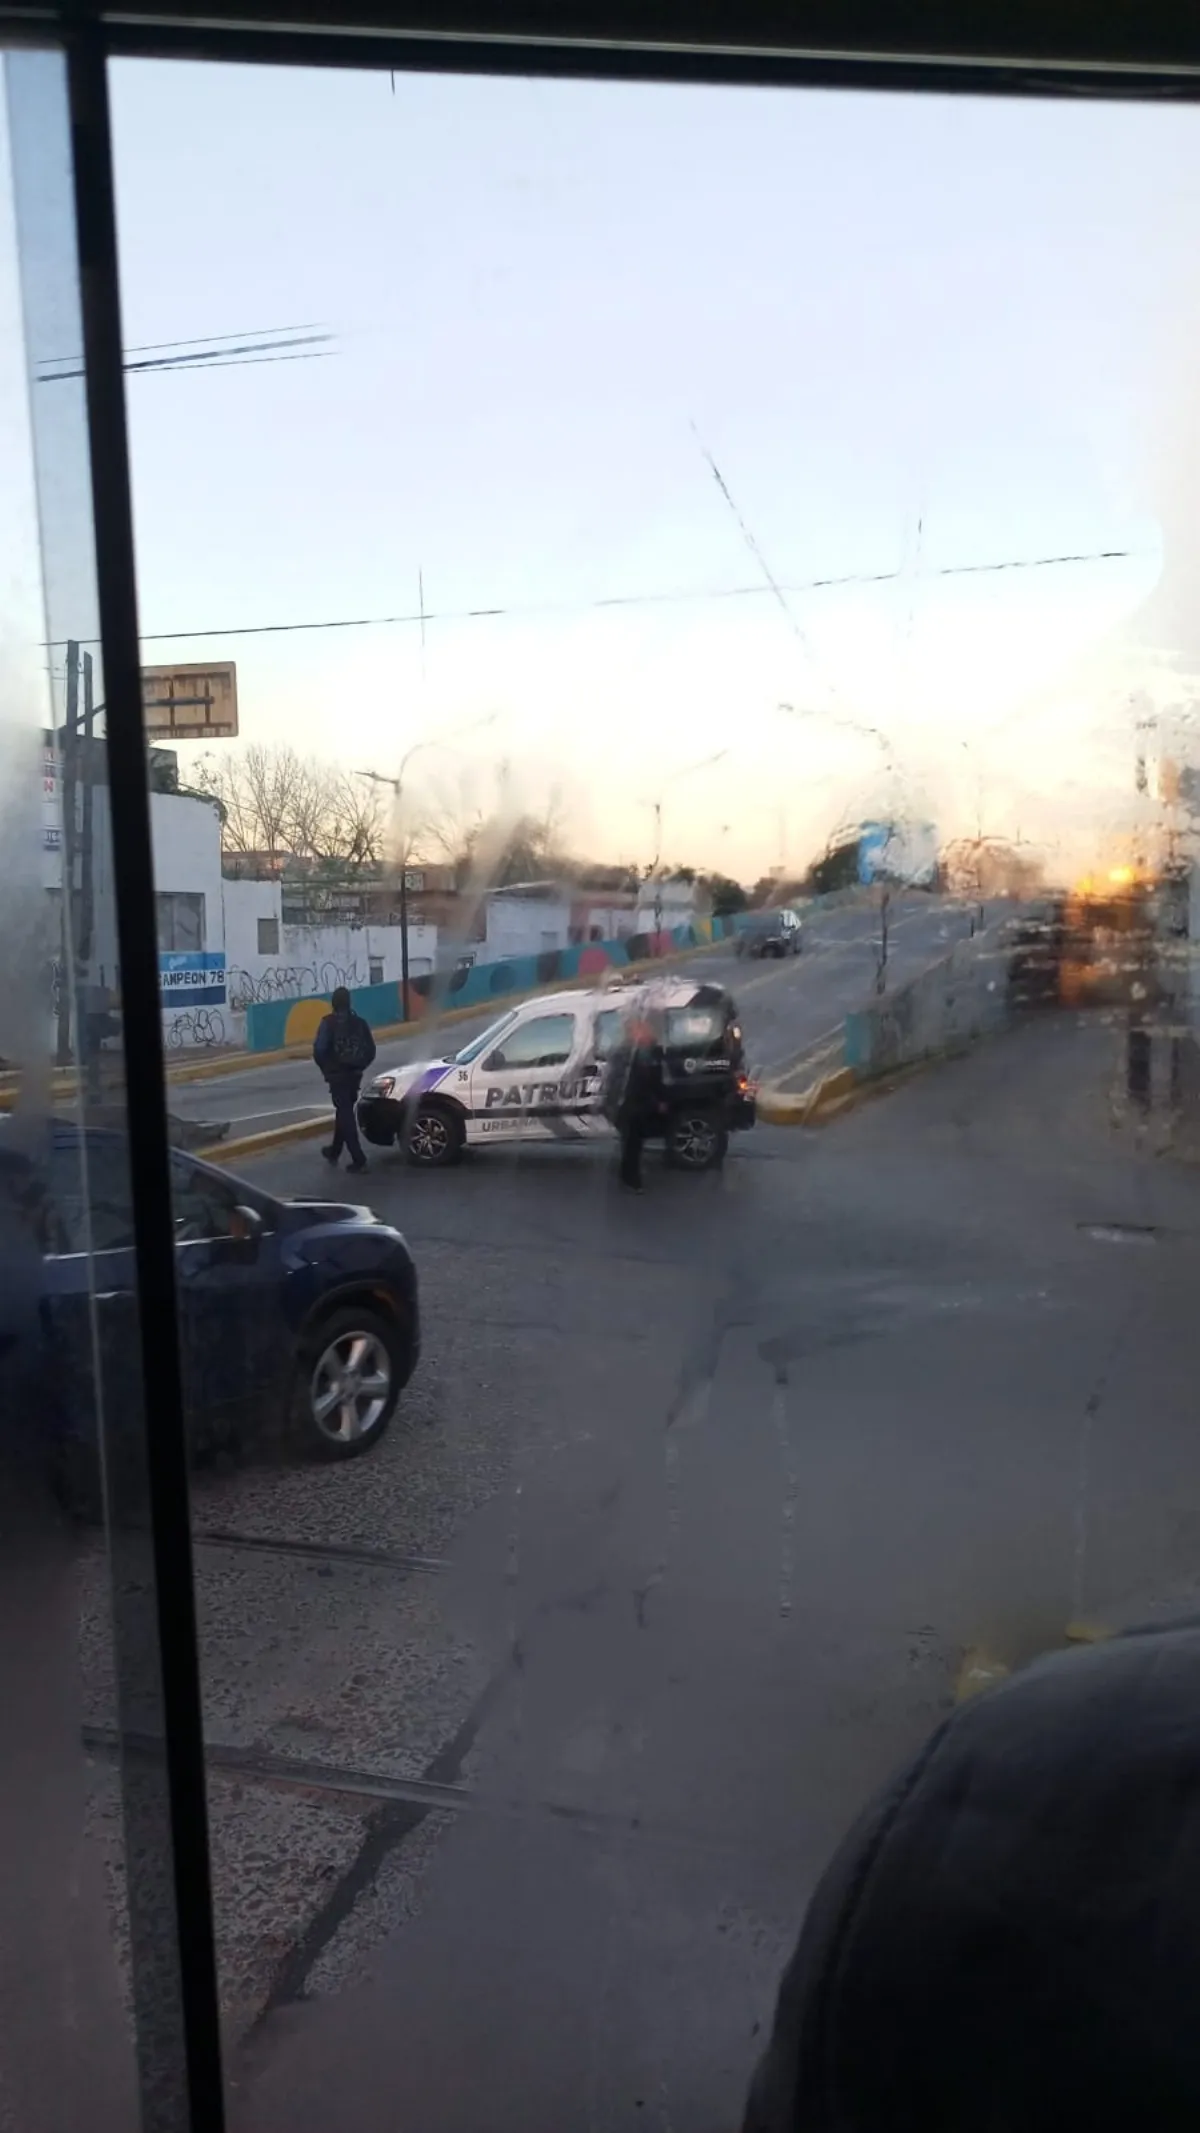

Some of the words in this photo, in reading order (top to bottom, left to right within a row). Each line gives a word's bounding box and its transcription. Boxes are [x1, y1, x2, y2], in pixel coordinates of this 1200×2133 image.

[158, 970, 206, 986] AMPEON
[210, 970, 225, 984] 78
[485, 1078, 596, 1108] PATRUL
